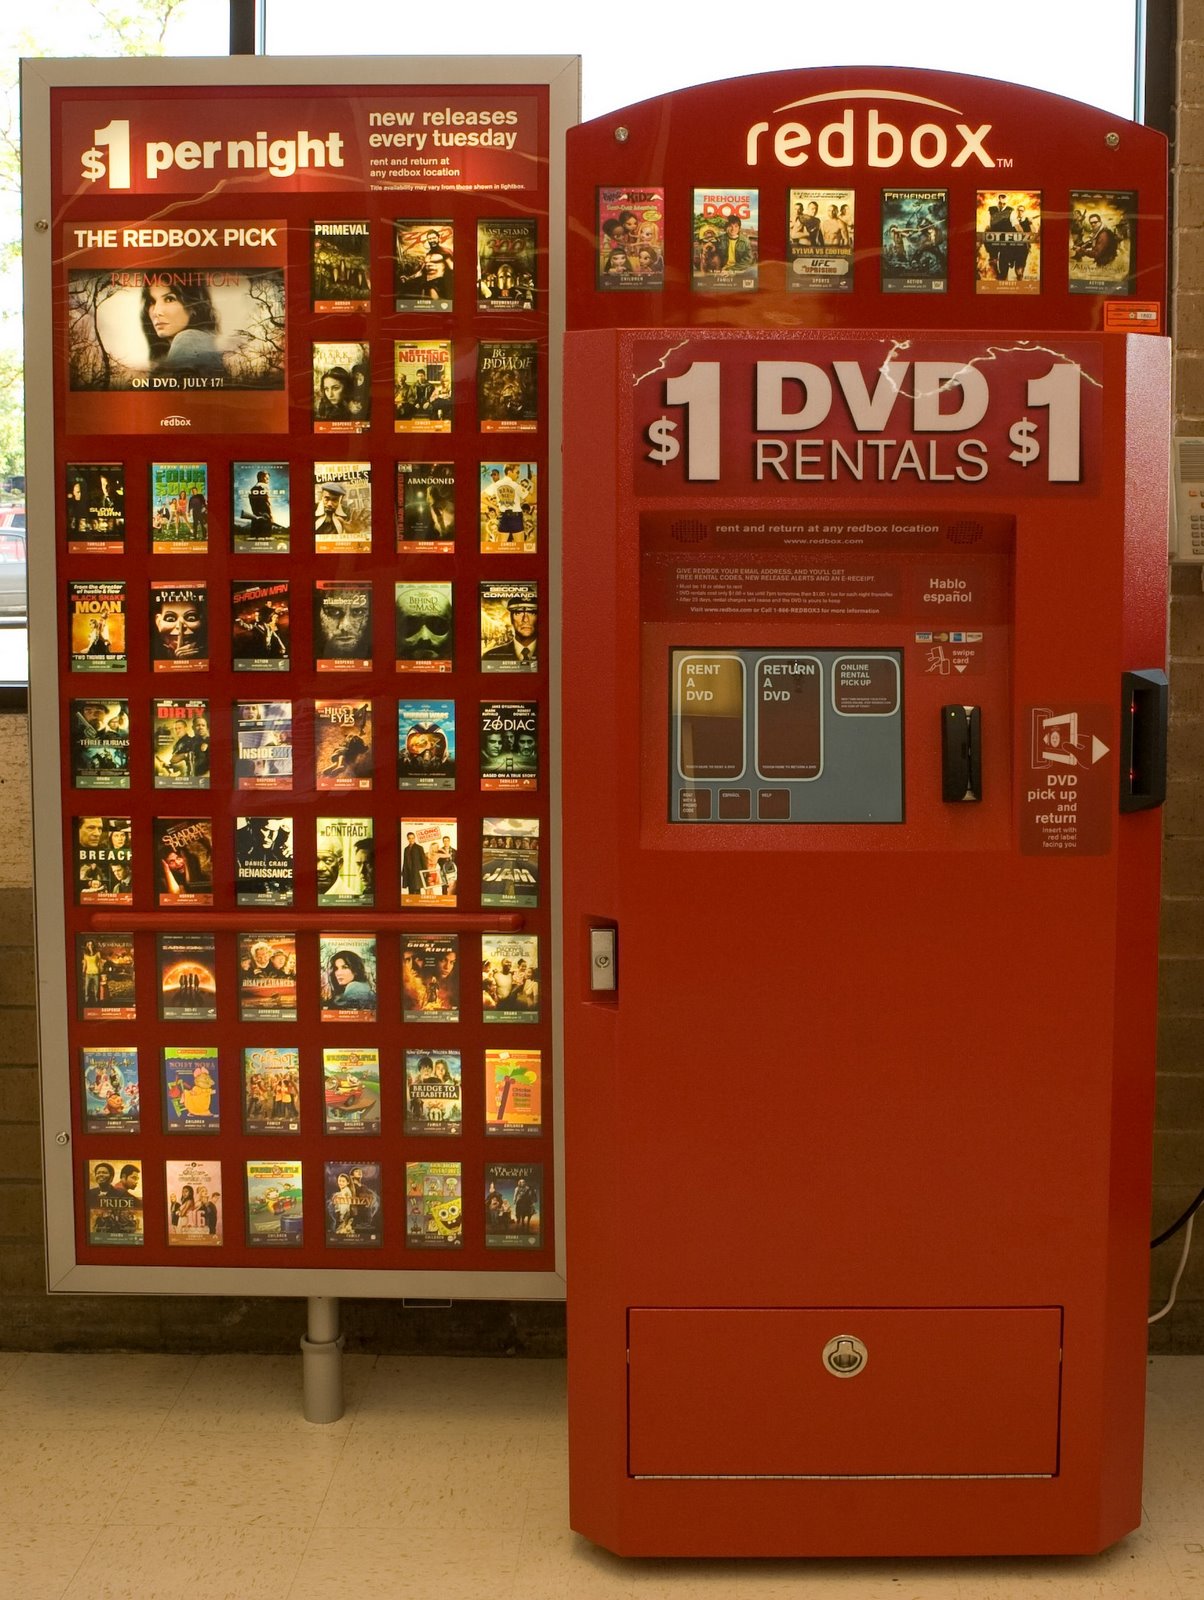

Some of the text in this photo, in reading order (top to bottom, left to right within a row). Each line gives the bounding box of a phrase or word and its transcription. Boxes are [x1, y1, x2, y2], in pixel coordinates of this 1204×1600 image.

[369, 108, 518, 126] new releases
[368, 128, 518, 151] every tuesday
[747, 109, 1013, 168] redbox TM
[81, 119, 344, 188] $1 per night
[370, 157, 450, 166] rent and return at
[370, 168, 460, 178] any redbox location
[884, 192, 946, 202] PATHFINDER
[703, 202, 750, 220] DOG
[314, 224, 370, 236] PRIMEVAL
[74, 228, 278, 248] THE REDBOX PICK
[111, 272, 240, 288] PREMONITION
[398, 350, 448, 362] NOTHING
[132, 378, 150, 388] ON
[183, 378, 208, 390] JULY
[210, 377, 224, 388] 17!
[160, 416, 191, 426] redbox
[648, 361, 1080, 482] $1 DVD $1
[756, 438, 988, 481] RENTALS
[316, 471, 369, 482] CHAPPELLE'S
[716, 524, 940, 534] rent and return at any redbox location
[930, 578, 966, 588] Hablo
[352, 594, 366, 606] 23
[923, 591, 972, 603] español
[76, 600, 122, 614] MOAN
[686, 665, 720, 675] RENT
[763, 665, 815, 675] RETURN
[686, 678, 695, 688] A
[763, 678, 772, 688] A
[686, 691, 713, 700] DVD
[763, 691, 790, 700] DVD
[158, 707, 204, 719] DIRTY
[331, 714, 355, 723] EYES
[482, 717, 535, 731] ZODIAC
[1047, 775, 1078, 786] DVD
[1028, 789, 1077, 802] pick up
[1057, 803, 1077, 812] and
[1036, 813, 1076, 823] return
[326, 826, 368, 836] CONTRACT
[80, 850, 132, 860] BREACH
[239, 868, 293, 878] RENAISSANCE
[482, 868, 536, 883] JAM
[100, 1198, 134, 1208] PRIDE
